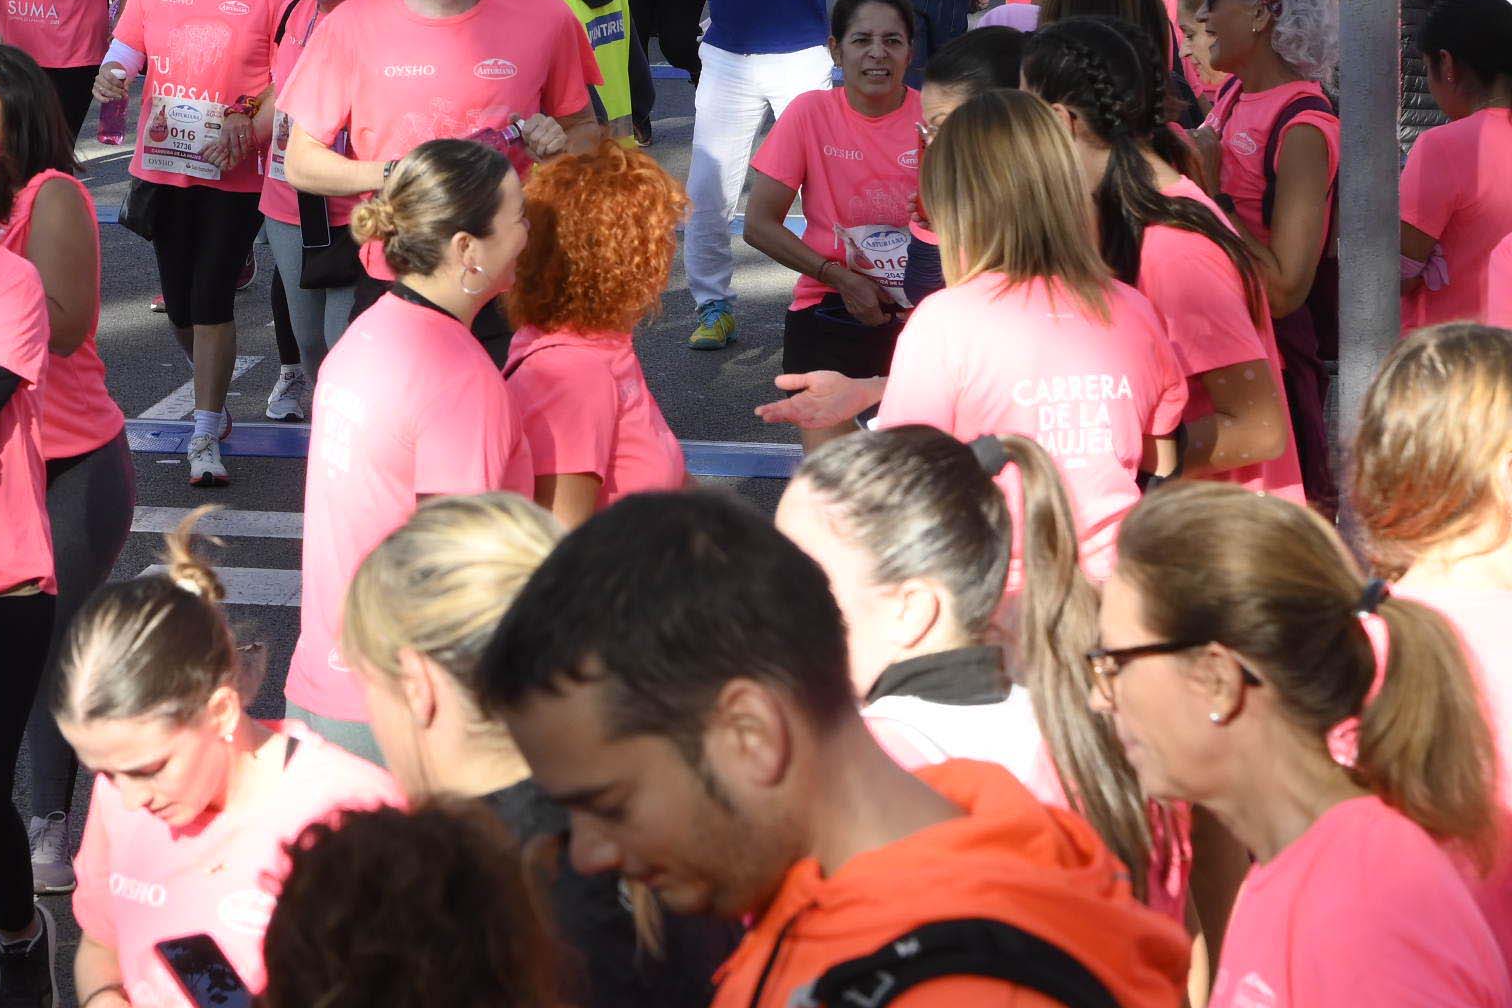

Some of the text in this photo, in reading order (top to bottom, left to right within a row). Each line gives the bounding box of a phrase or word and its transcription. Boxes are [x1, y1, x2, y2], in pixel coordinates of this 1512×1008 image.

[8, 0, 59, 19] SUMA
[150, 55, 170, 75] TU
[384, 65, 436, 78] OYSHO
[170, 126, 196, 140] 016
[823, 144, 864, 161] OYSHO
[873, 255, 908, 270] 016
[1013, 373, 1133, 406] CARRERA
[1039, 401, 1111, 432] DE LA
